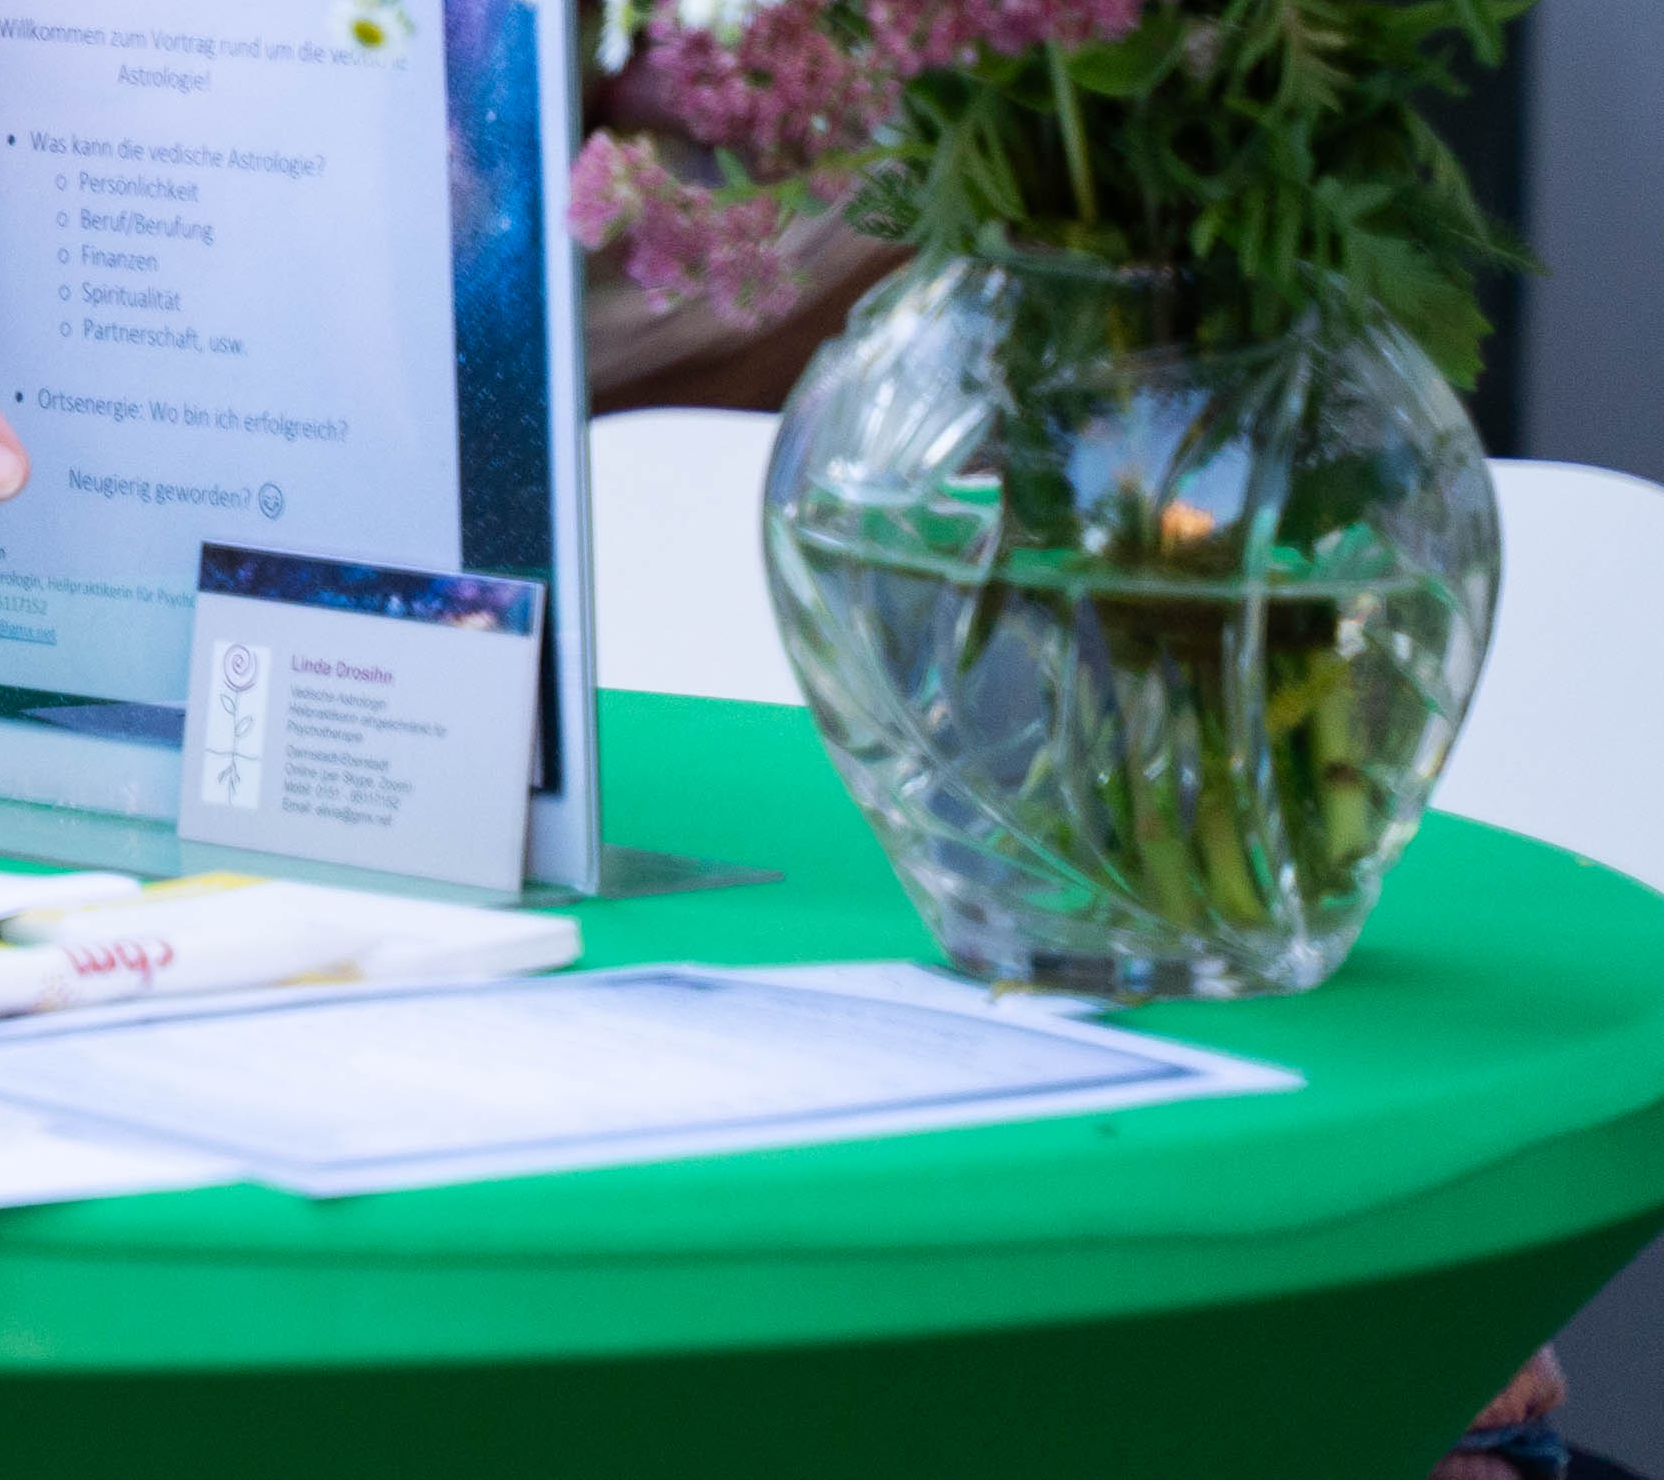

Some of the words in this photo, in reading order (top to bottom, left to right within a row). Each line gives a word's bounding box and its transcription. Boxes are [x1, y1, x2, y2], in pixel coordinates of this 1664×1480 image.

[111, 30, 146, 48] zum
[151, 29, 216, 59] Vortrag
[220, 34, 261, 58] rund
[265, 44, 295, 62] um
[299, 39, 325, 64] die
[117, 63, 211, 91] Astrologie!
[30, 130, 66, 154] Was
[71, 133, 112, 157] kann
[118, 137, 144, 160] die
[148, 139, 223, 169] vedische
[227, 148, 327, 180] Astrologie?
[78, 171, 200, 203] Persönlichkeit
[80, 208, 214, 247] Beruf/Berufung
[81, 244, 159, 272] Finanzen
[82, 281, 182, 312] Spiritualität
[83, 318, 205, 354] Partnerschaft,
[210, 335, 248, 357] usw.
[38, 387, 143, 423] Ortsenergie:
[148, 399, 179, 424] Wo
[183, 401, 209, 427] bin
[215, 407, 238, 431] ich
[244, 410, 349, 442] erfolgreich?
[69, 466, 151, 504] Neugierig
[155, 483, 252, 510] geworden?
[291, 654, 331, 677] Linda
[336, 660, 394, 684] Drosihn
